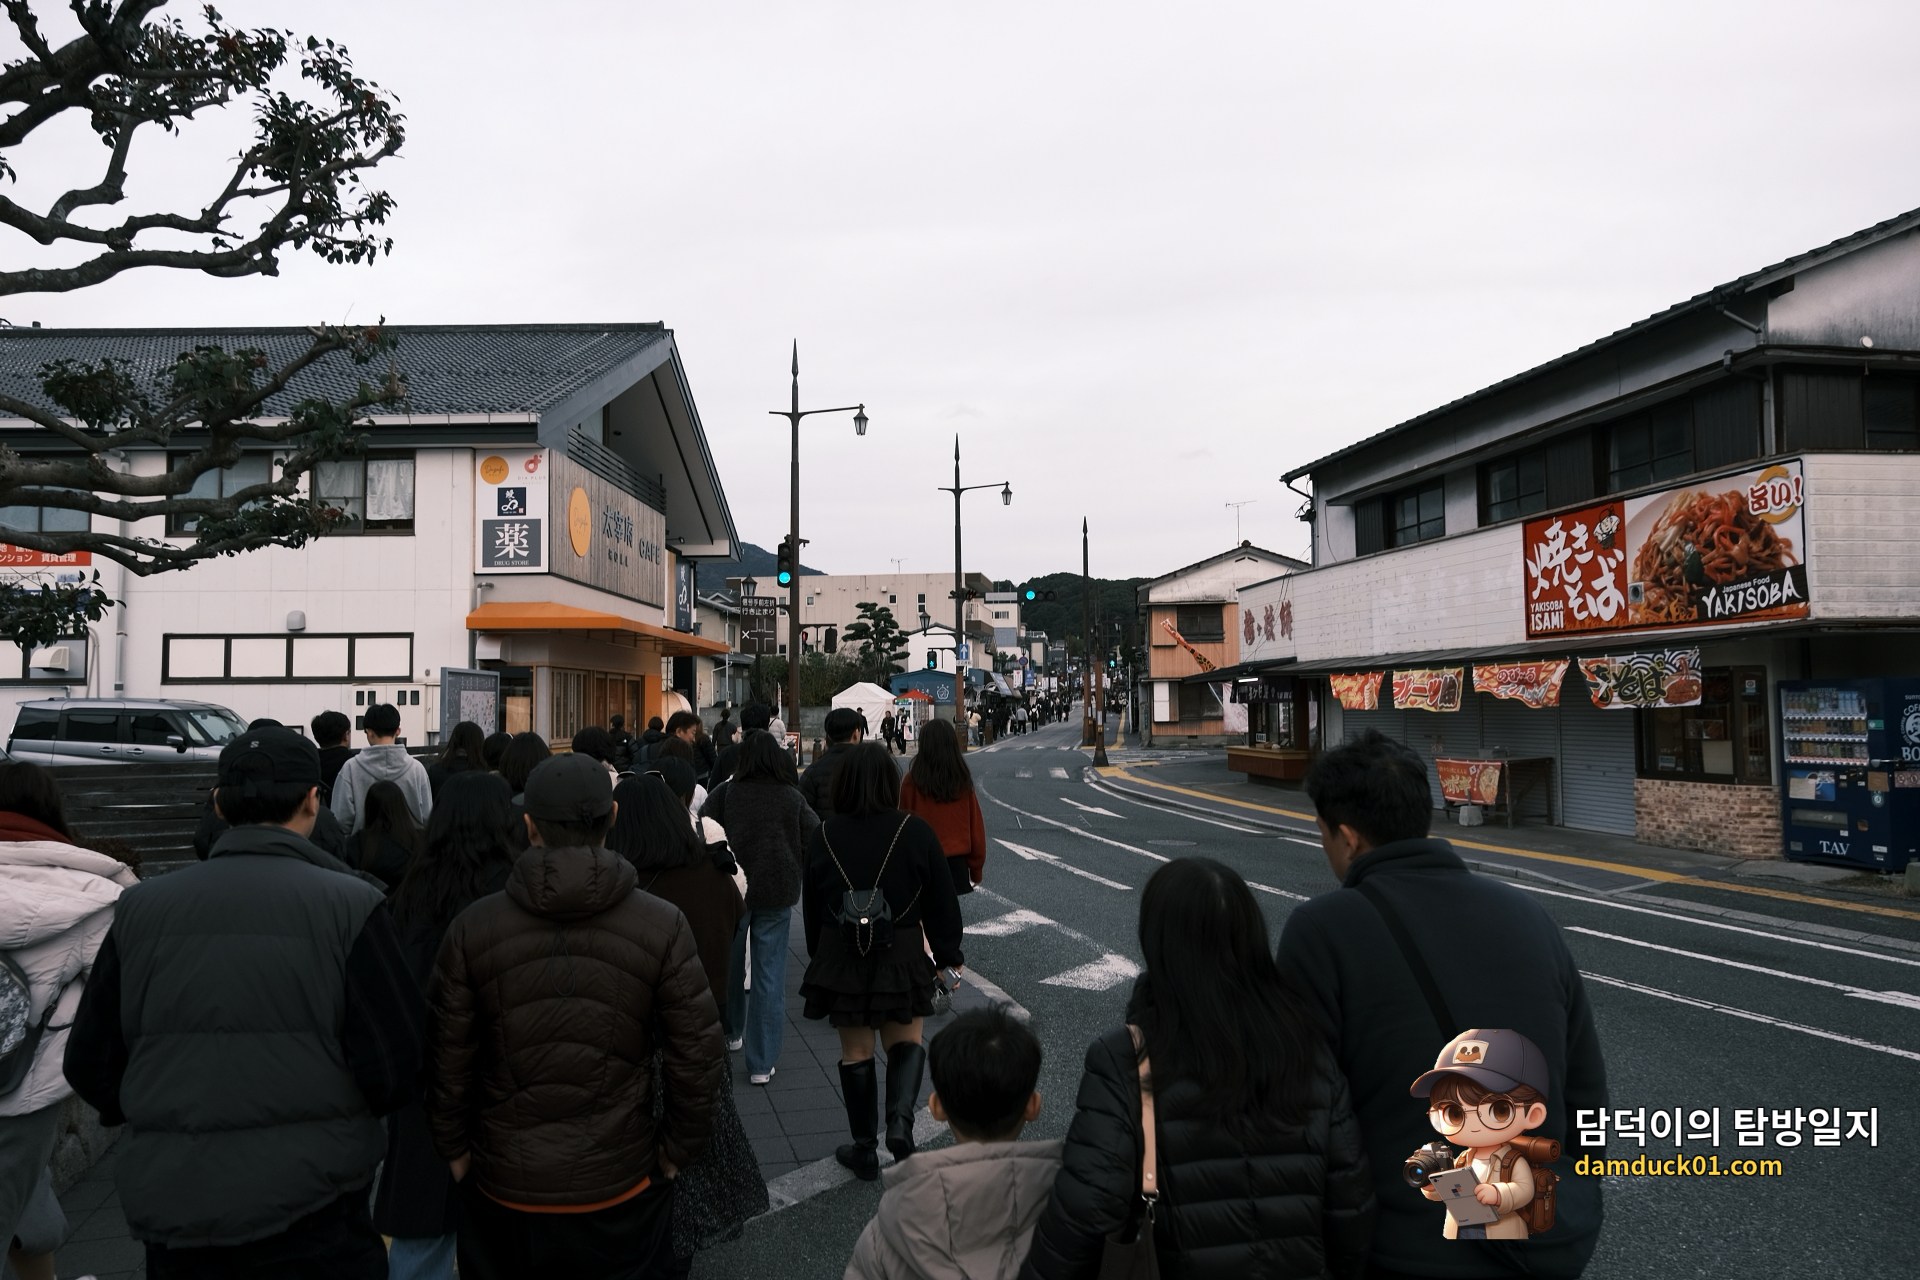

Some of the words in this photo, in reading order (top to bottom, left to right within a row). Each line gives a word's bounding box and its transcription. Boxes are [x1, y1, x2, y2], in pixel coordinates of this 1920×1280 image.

[494, 523, 530, 559] 薬
[603, 505, 634, 549] 太宰府
[639, 538, 662, 566] CAFE
[1701, 570, 1803, 619] YAKISOBA
[1722, 581, 1752, 594] Japanese
[1752, 575, 1771, 587] Food
[742, 607, 775, 616] 行き止まり
[1530, 600, 1564, 613] YAKISOBA
[1531, 611, 1565, 631] ISAMI
